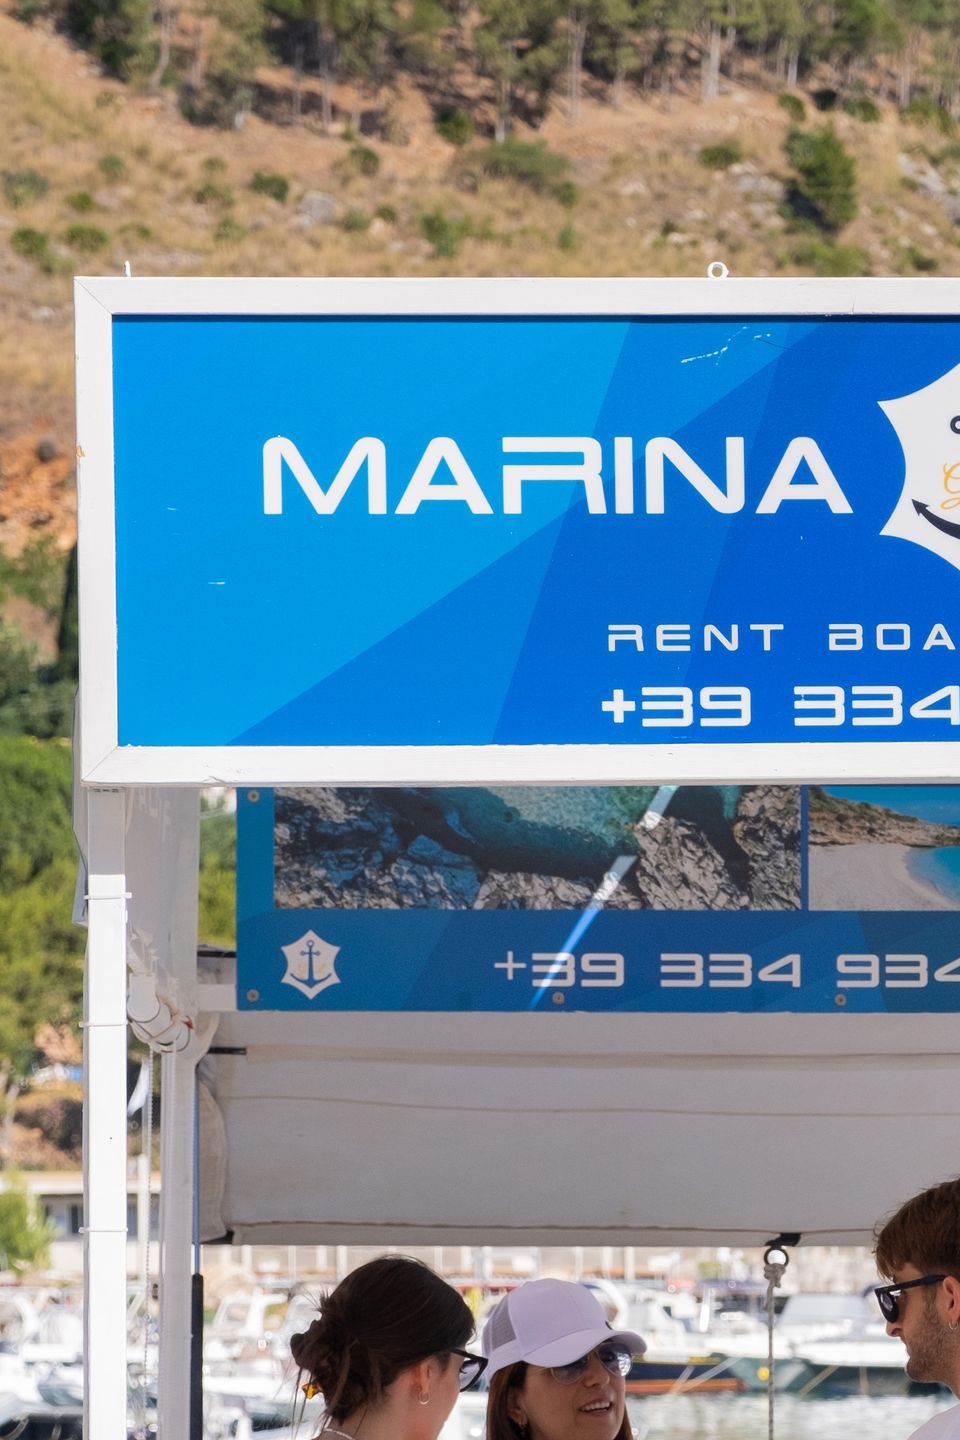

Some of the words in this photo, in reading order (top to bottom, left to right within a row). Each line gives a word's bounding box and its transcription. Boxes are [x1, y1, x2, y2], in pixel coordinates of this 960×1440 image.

[262, 436, 853, 515] MARINA
[608, 624, 784, 651] RENT
[601, 686, 752, 727] +39
[794, 685, 960, 725] 334
[494, 951, 625, 987] +39
[660, 953, 801, 987] 334
